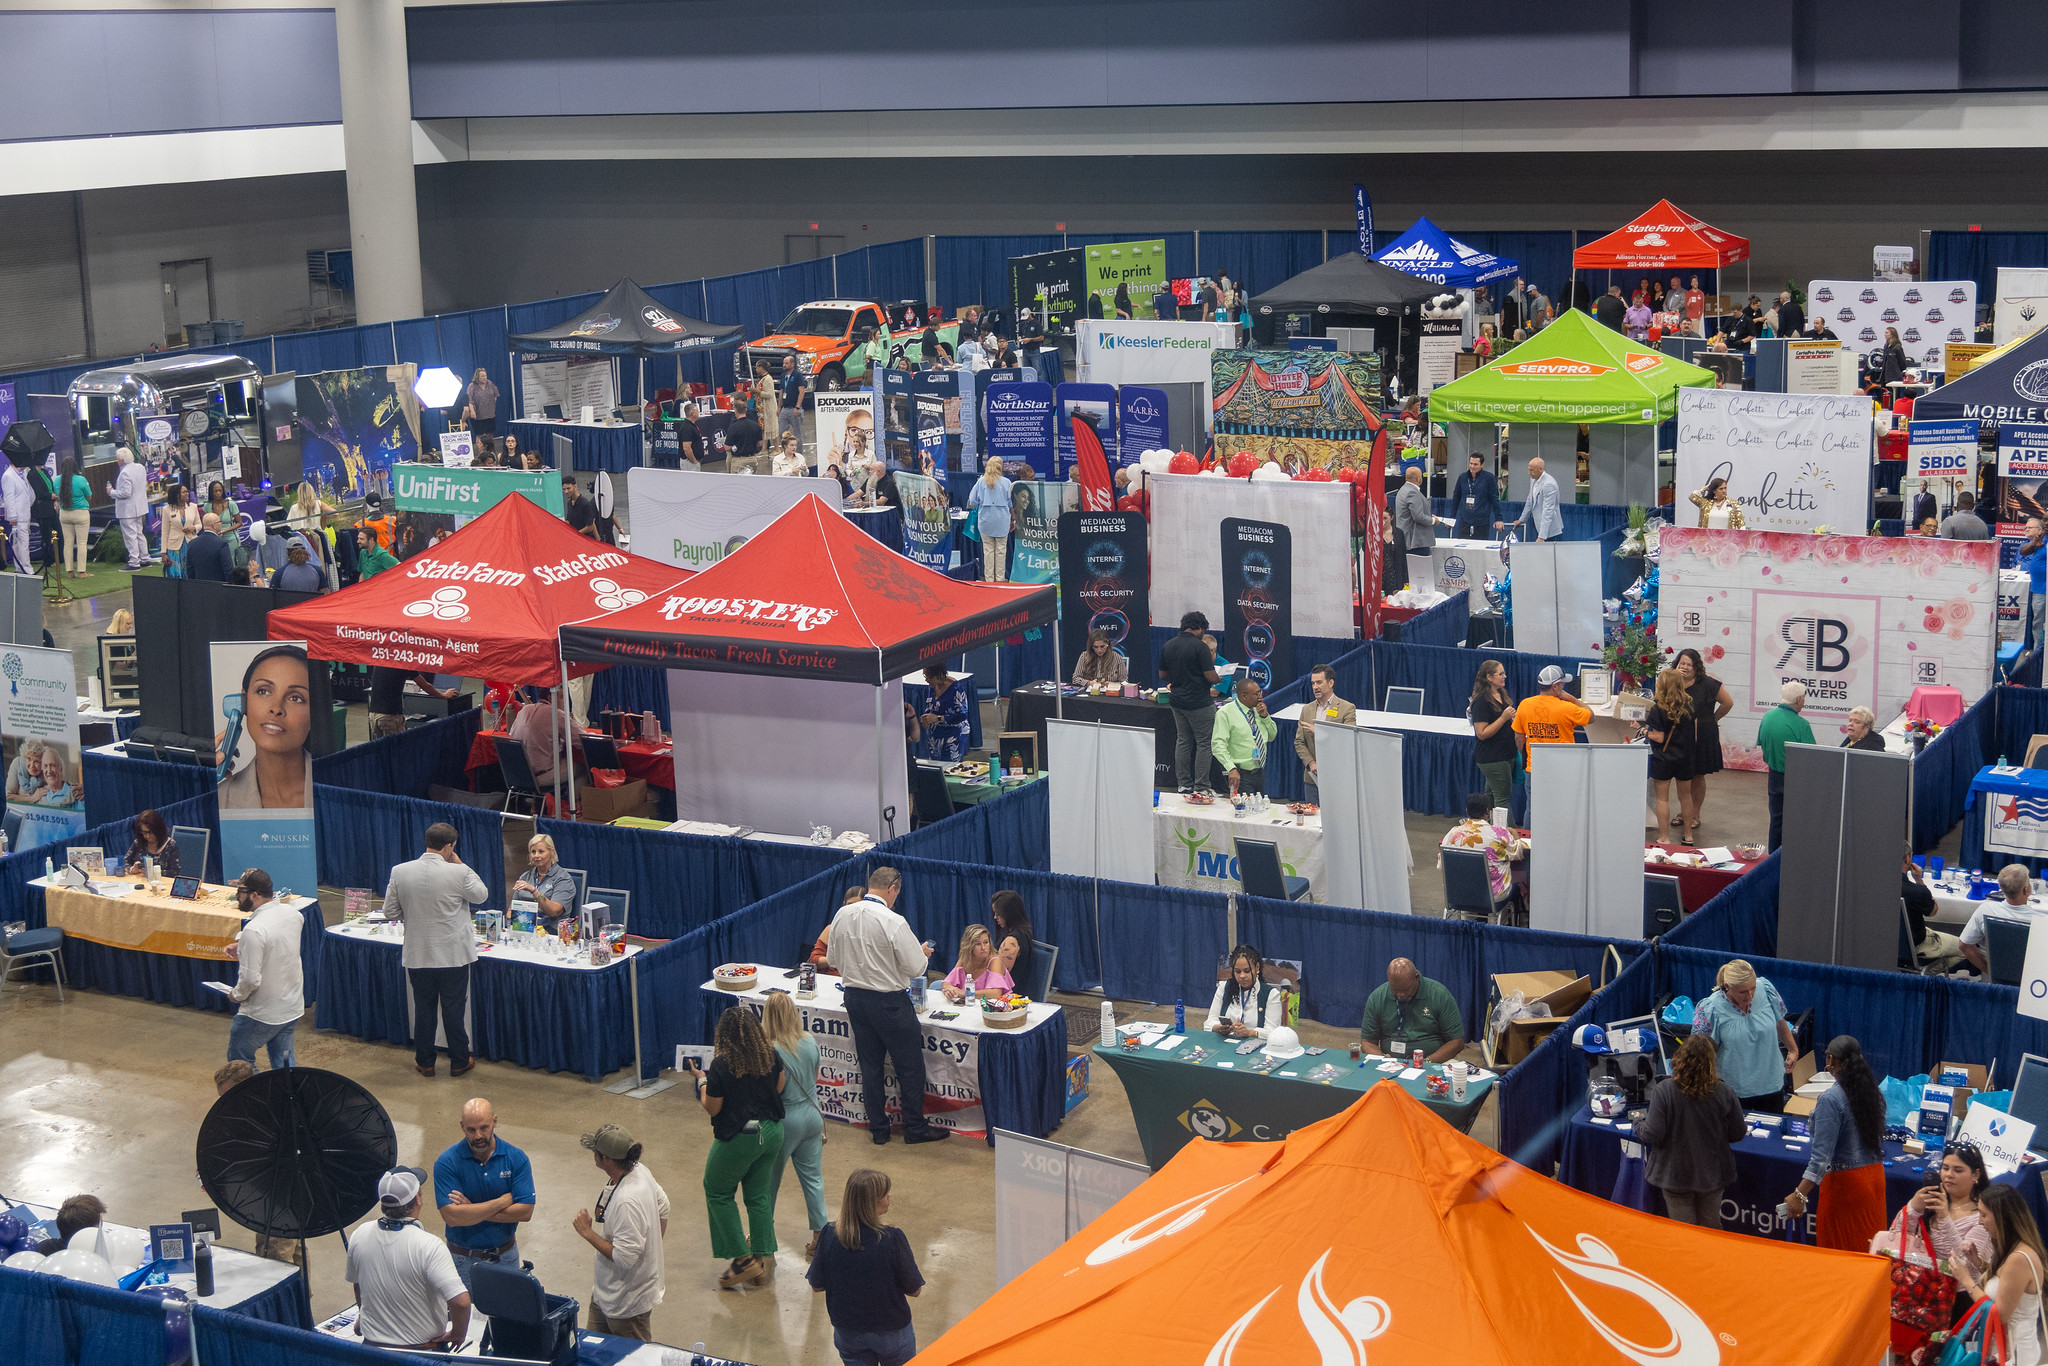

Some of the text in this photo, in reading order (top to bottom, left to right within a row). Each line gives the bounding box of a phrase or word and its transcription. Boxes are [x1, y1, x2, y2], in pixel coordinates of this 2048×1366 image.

[1625, 224, 1685, 233] StateFarm
[1100, 264, 1152, 281] We print
[1050, 280, 1070, 298] print
[560, 341, 576, 349] SOUND
[584, 342, 600, 350] MOBILE
[682, 338, 694, 348] SOUND
[1117, 336, 1211, 350] KeeslerFederal
[1518, 364, 1590, 373] SERVPRO
[1270, 372, 1303, 383] OYSTER
[1274, 382, 1302, 392] HOUSE
[990, 400, 1049, 410] NorthStar
[1272, 396, 1319, 408] BOARDWALK
[1446, 401, 1471, 412] Like
[1474, 401, 1482, 412] it
[1486, 402, 1520, 412] never
[1524, 404, 1562, 413] even
[1680, 393, 1716, 413] Confetti
[1728, 396, 1764, 416] Confetti
[1127, 405, 1160, 417] M.A.R.R.S.
[1777, 400, 1814, 419] Confetti
[1823, 401, 1861, 420] Confetti
[1963, 405, 2038, 420] MOBILE
[960, 390, 973, 451] HELICAL
[918, 426, 944, 439] SCIENCE
[1680, 424, 1715, 444] Confetti
[1726, 428, 1764, 447] Confetti
[922, 436, 941, 447] TO GO
[1775, 430, 1813, 450] Confetti
[1822, 433, 1860, 452] Confetti
[1920, 456, 1966, 469] SBDC
[398, 474, 480, 503] UniFirst
[920, 521, 944, 532] YOUR
[1026, 517, 1043, 527] FILL
[1081, 525, 1126, 533] BUSINESS
[1238, 526, 1273, 536] MEDIACOM
[1238, 533, 1274, 543] BUSINESS
[1022, 538, 1042, 549] GAPS
[673, 538, 722, 565] Payroll
[407, 559, 526, 586] StateFarm
[533, 550, 629, 585] StateFarm
[1243, 565, 1271, 574] INTERNET
[1237, 599, 1279, 610] DATA SECURITY
[657, 595, 838, 631] ROOSTERS
[740, 620, 786, 628] TEQUILA
[336, 626, 479, 655] Kimberly Coleman, Agent
[920, 610, 1029, 660] roostersdowntown.com
[372, 648, 444, 667] 251-243-0134
[603, 636, 836, 669] Friendly Tacos Fresh Service
[1250, 670, 1268, 679] VOICE
[20, 678, 67, 692] community
[332, 677, 372, 687] SAFETY
[1820, 680, 1847, 690] BUD
[820, 1045, 859, 1065] ttorney
[926, 1083, 974, 1099] INJURY
[1993, 1146, 2019, 1164] Bank
[1720, 1198, 1795, 1233] Origin
